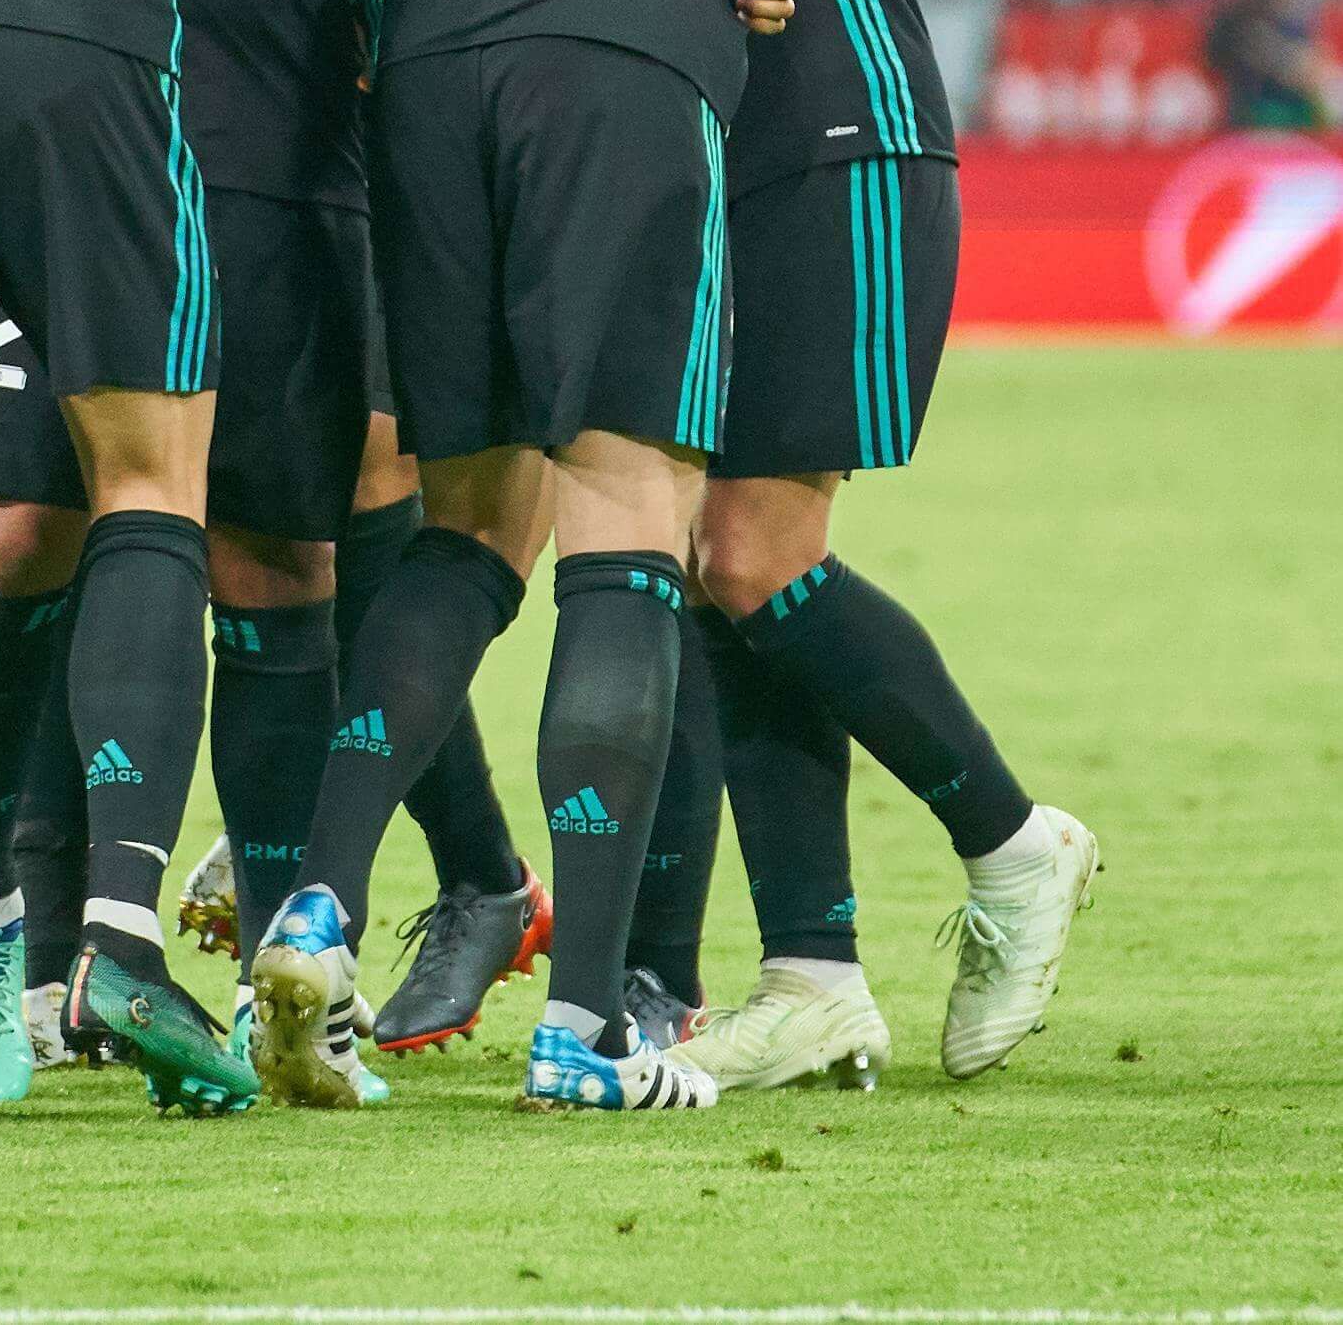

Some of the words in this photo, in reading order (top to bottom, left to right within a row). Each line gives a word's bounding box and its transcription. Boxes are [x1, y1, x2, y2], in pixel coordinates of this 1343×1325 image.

[330, 736, 393, 756] adidas
[85, 766, 143, 790] adidas
[550, 816, 620, 835] adidas
[245, 842, 308, 862] RMC
